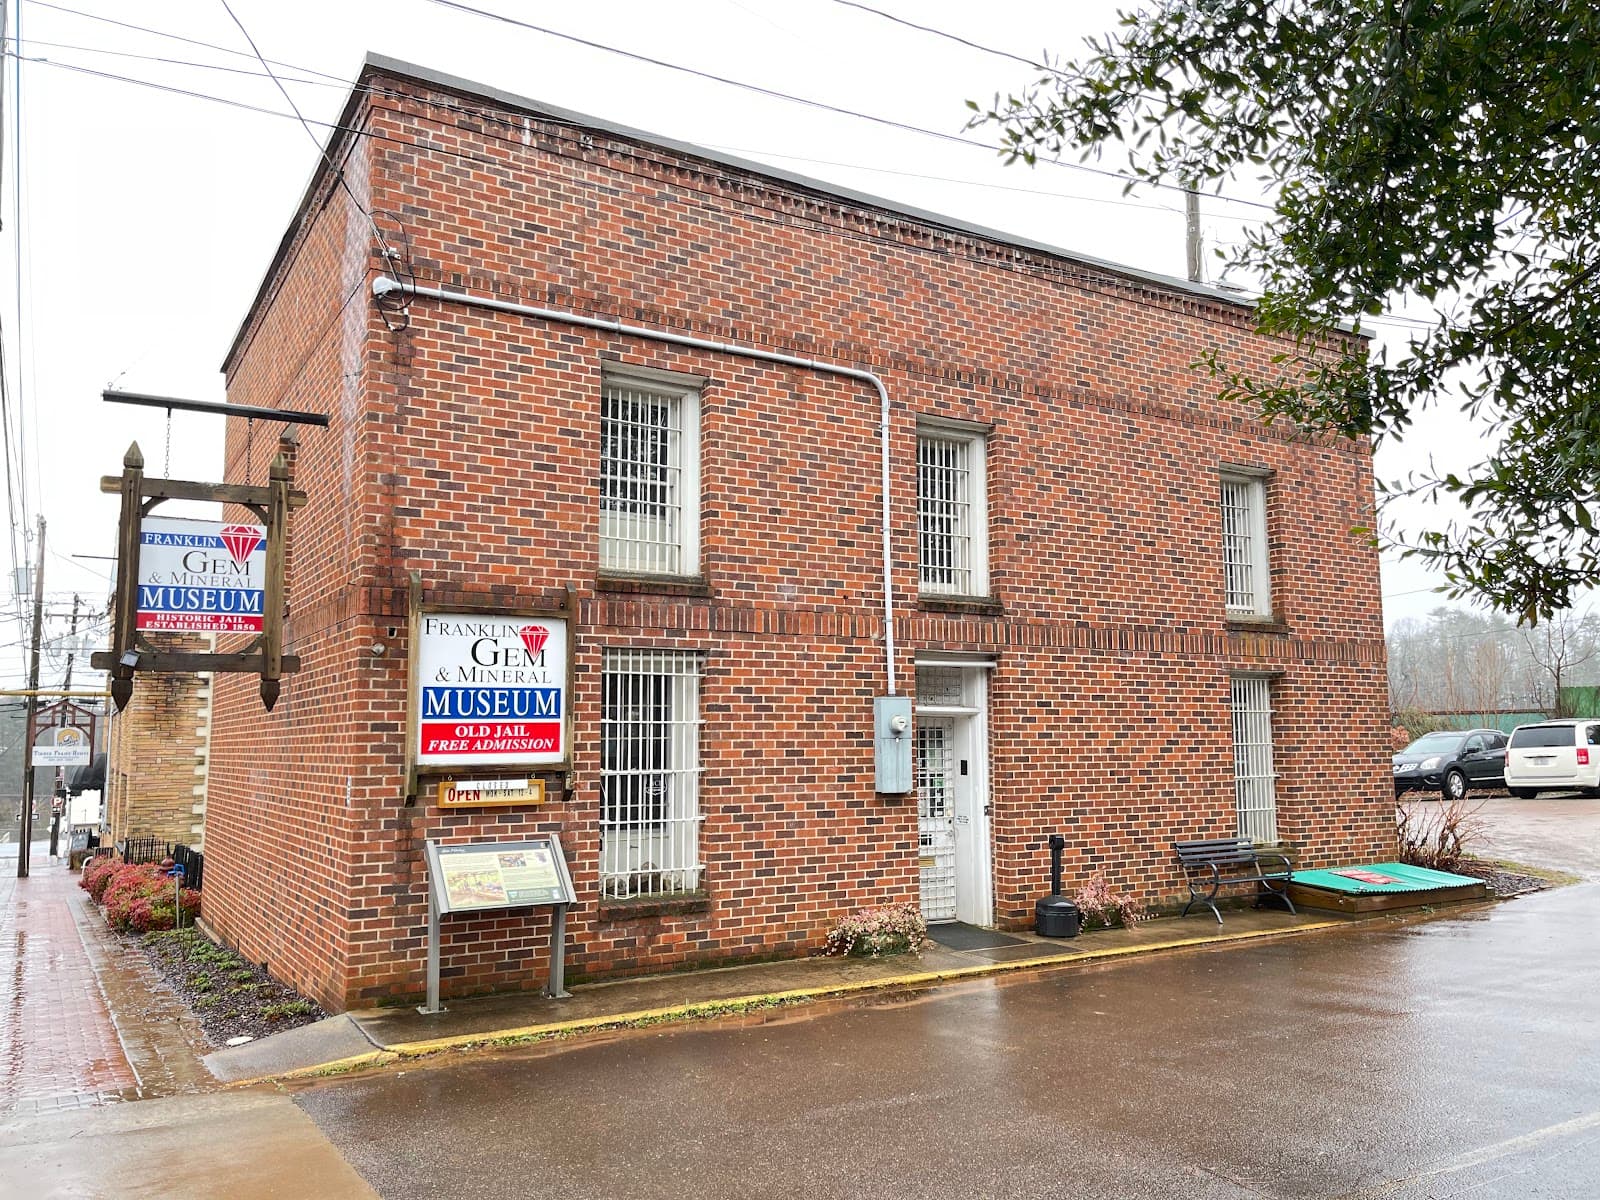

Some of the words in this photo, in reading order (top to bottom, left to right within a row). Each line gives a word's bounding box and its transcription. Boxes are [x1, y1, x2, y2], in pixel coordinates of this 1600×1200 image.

[145, 533, 218, 547] FRANKLIN
[182, 550, 251, 576] GEM
[148, 571, 162, 584] &
[170, 571, 256, 588] MINERAL
[141, 586, 261, 612] MUSEUM
[145, 621, 228, 631] ESTABLISHED
[232, 623, 256, 631] 1850
[156, 614, 215, 623] HISTORIC
[219, 616, 245, 624] JAIL
[425, 618, 519, 638] FRANKLIN
[471, 638, 547, 668] GEM
[435, 666, 451, 683] &
[457, 666, 552, 684] MINERAL
[425, 689, 558, 717] MUSEUM
[455, 725, 491, 738] OLD
[494, 725, 530, 738] JAIL
[427, 739, 470, 751] FREE
[473, 738, 555, 751] ADMISSION
[448, 788, 480, 801] OPEN
